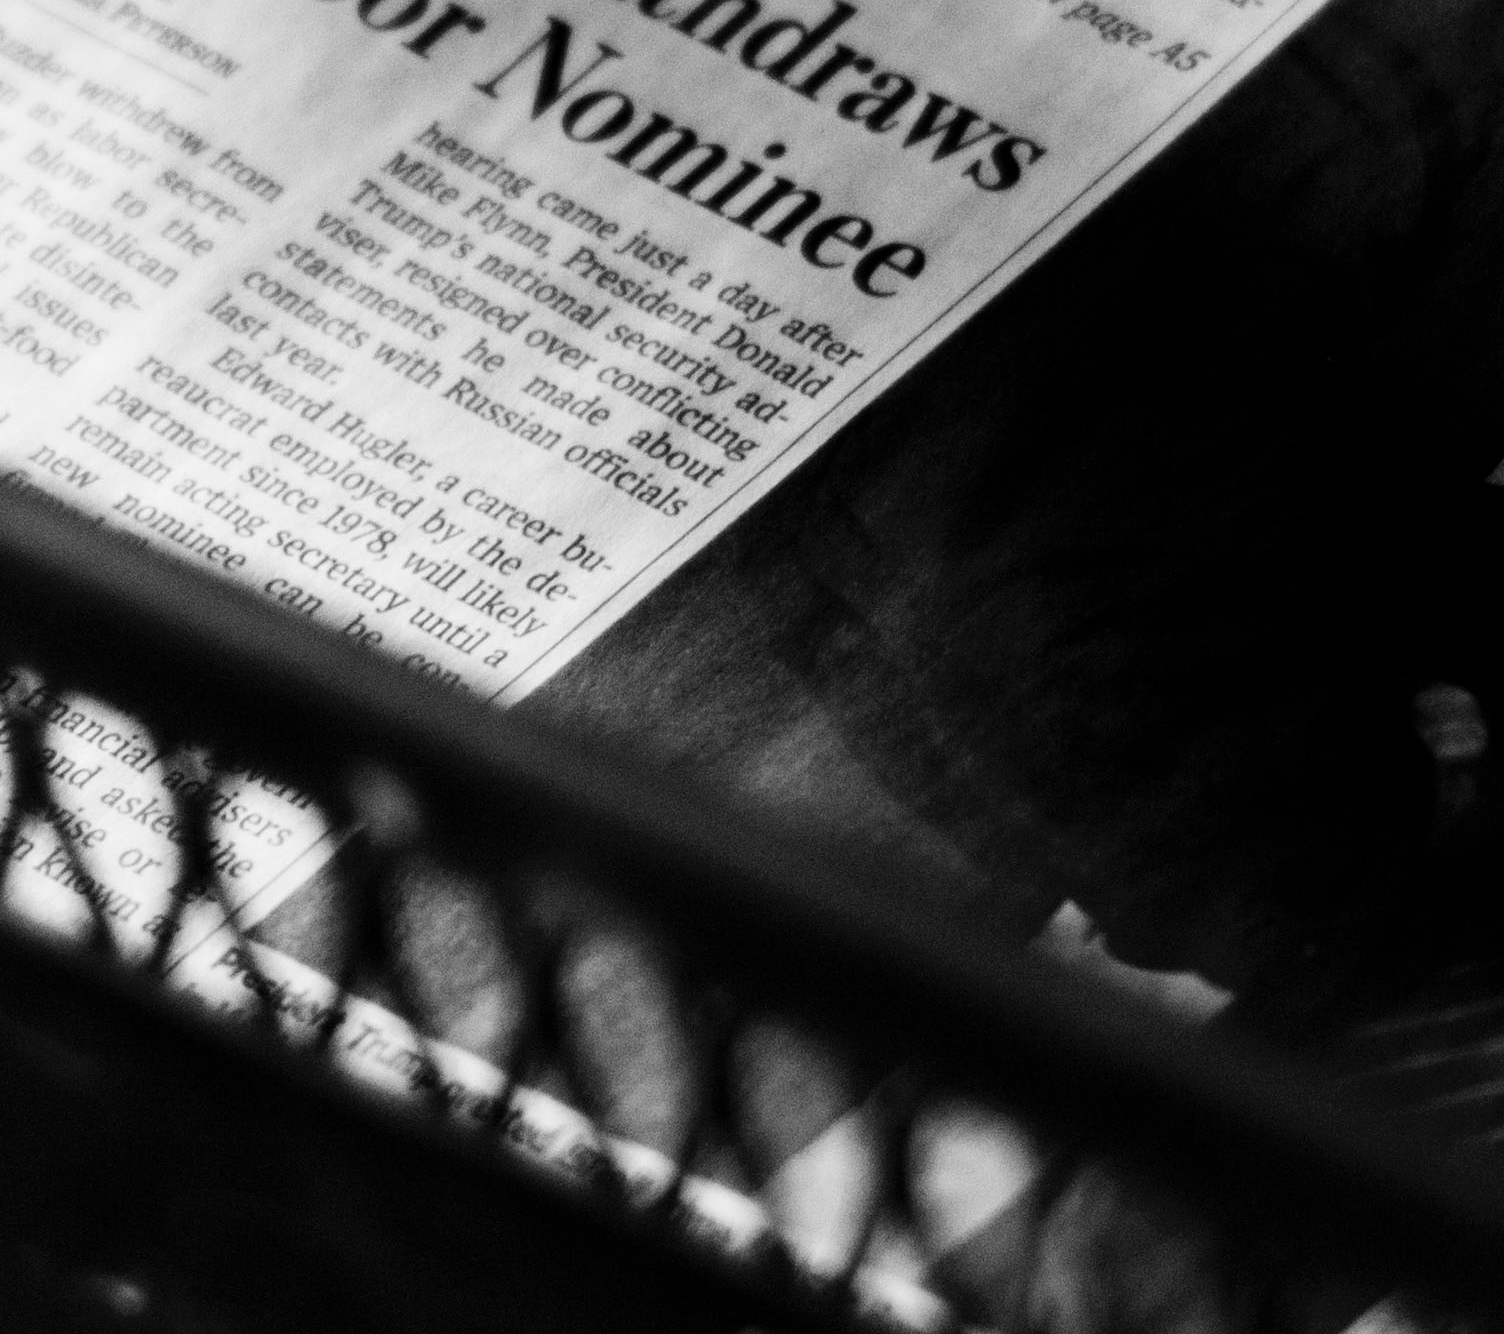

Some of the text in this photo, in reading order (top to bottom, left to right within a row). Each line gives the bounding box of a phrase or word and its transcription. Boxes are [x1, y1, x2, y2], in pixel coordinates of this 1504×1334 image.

[381, 150, 834, 399] Mike Flynn, President Donald
[414, 120, 864, 367] hearing came just a day after
[474, 14, 928, 300] Nominee
[205, 290, 344, 386] last year.
[209, 345, 613, 572] Edward Hugler, a career bu-
[241, 269, 689, 516] contacts with Russian officials
[274, 241, 725, 488] statements he made about
[314, 210, 760, 462] viser, resigned over conflicting
[474, 253, 612, 330] national
[604, 323, 737, 396] security
[734, 391, 789, 424] ad-
[28, 441, 386, 651] new nominee can be
[63, 414, 508, 668] remain acting secretary until a
[94, 384, 547, 637] partment since 1978, will likely
[135, 354, 577, 600] reaucrat employed by the de-
[34, 845, 144, 922] known
[40, 746, 103, 790] and
[118, 847, 163, 878] or
